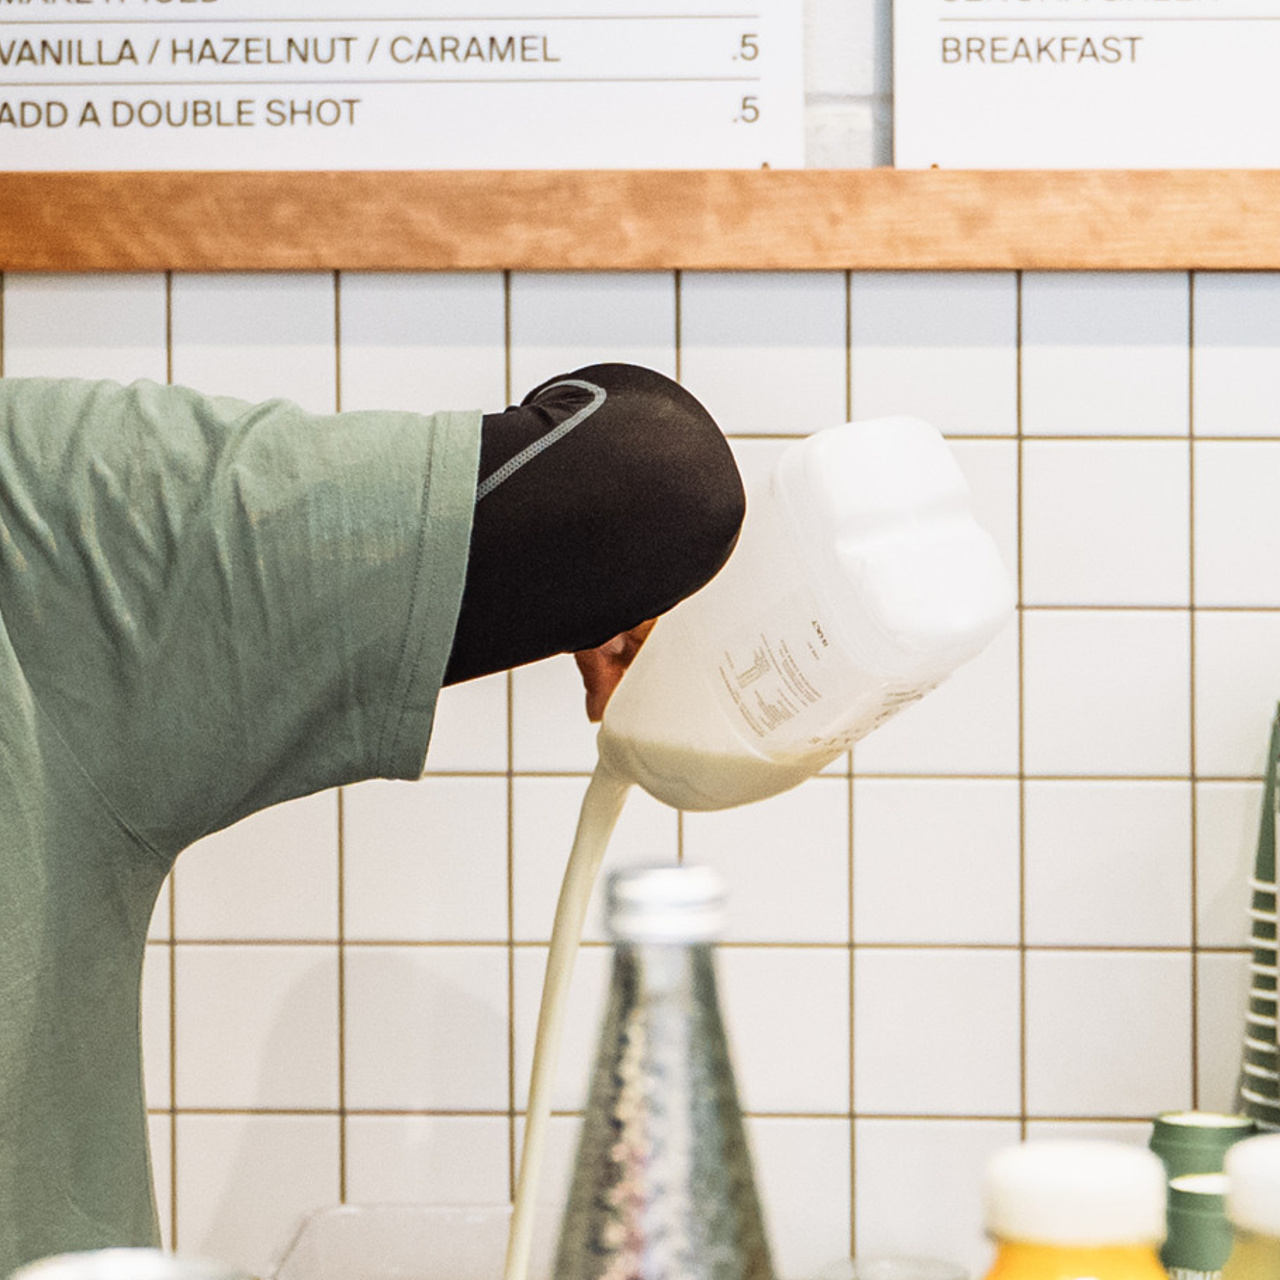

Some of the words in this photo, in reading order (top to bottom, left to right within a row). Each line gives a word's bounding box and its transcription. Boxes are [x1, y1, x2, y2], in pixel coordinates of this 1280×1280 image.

[171, 36, 358, 65] HAZELNUT
[389, 35, 560, 64] CARAMEL
[730, 33, 759, 62] .5
[941, 36, 1143, 64] BREAKFAST
[78, 100, 101, 127] A
[111, 99, 254, 128] DOUBLE
[265, 98, 361, 127] SHOT
[733, 95, 760, 124] .5
